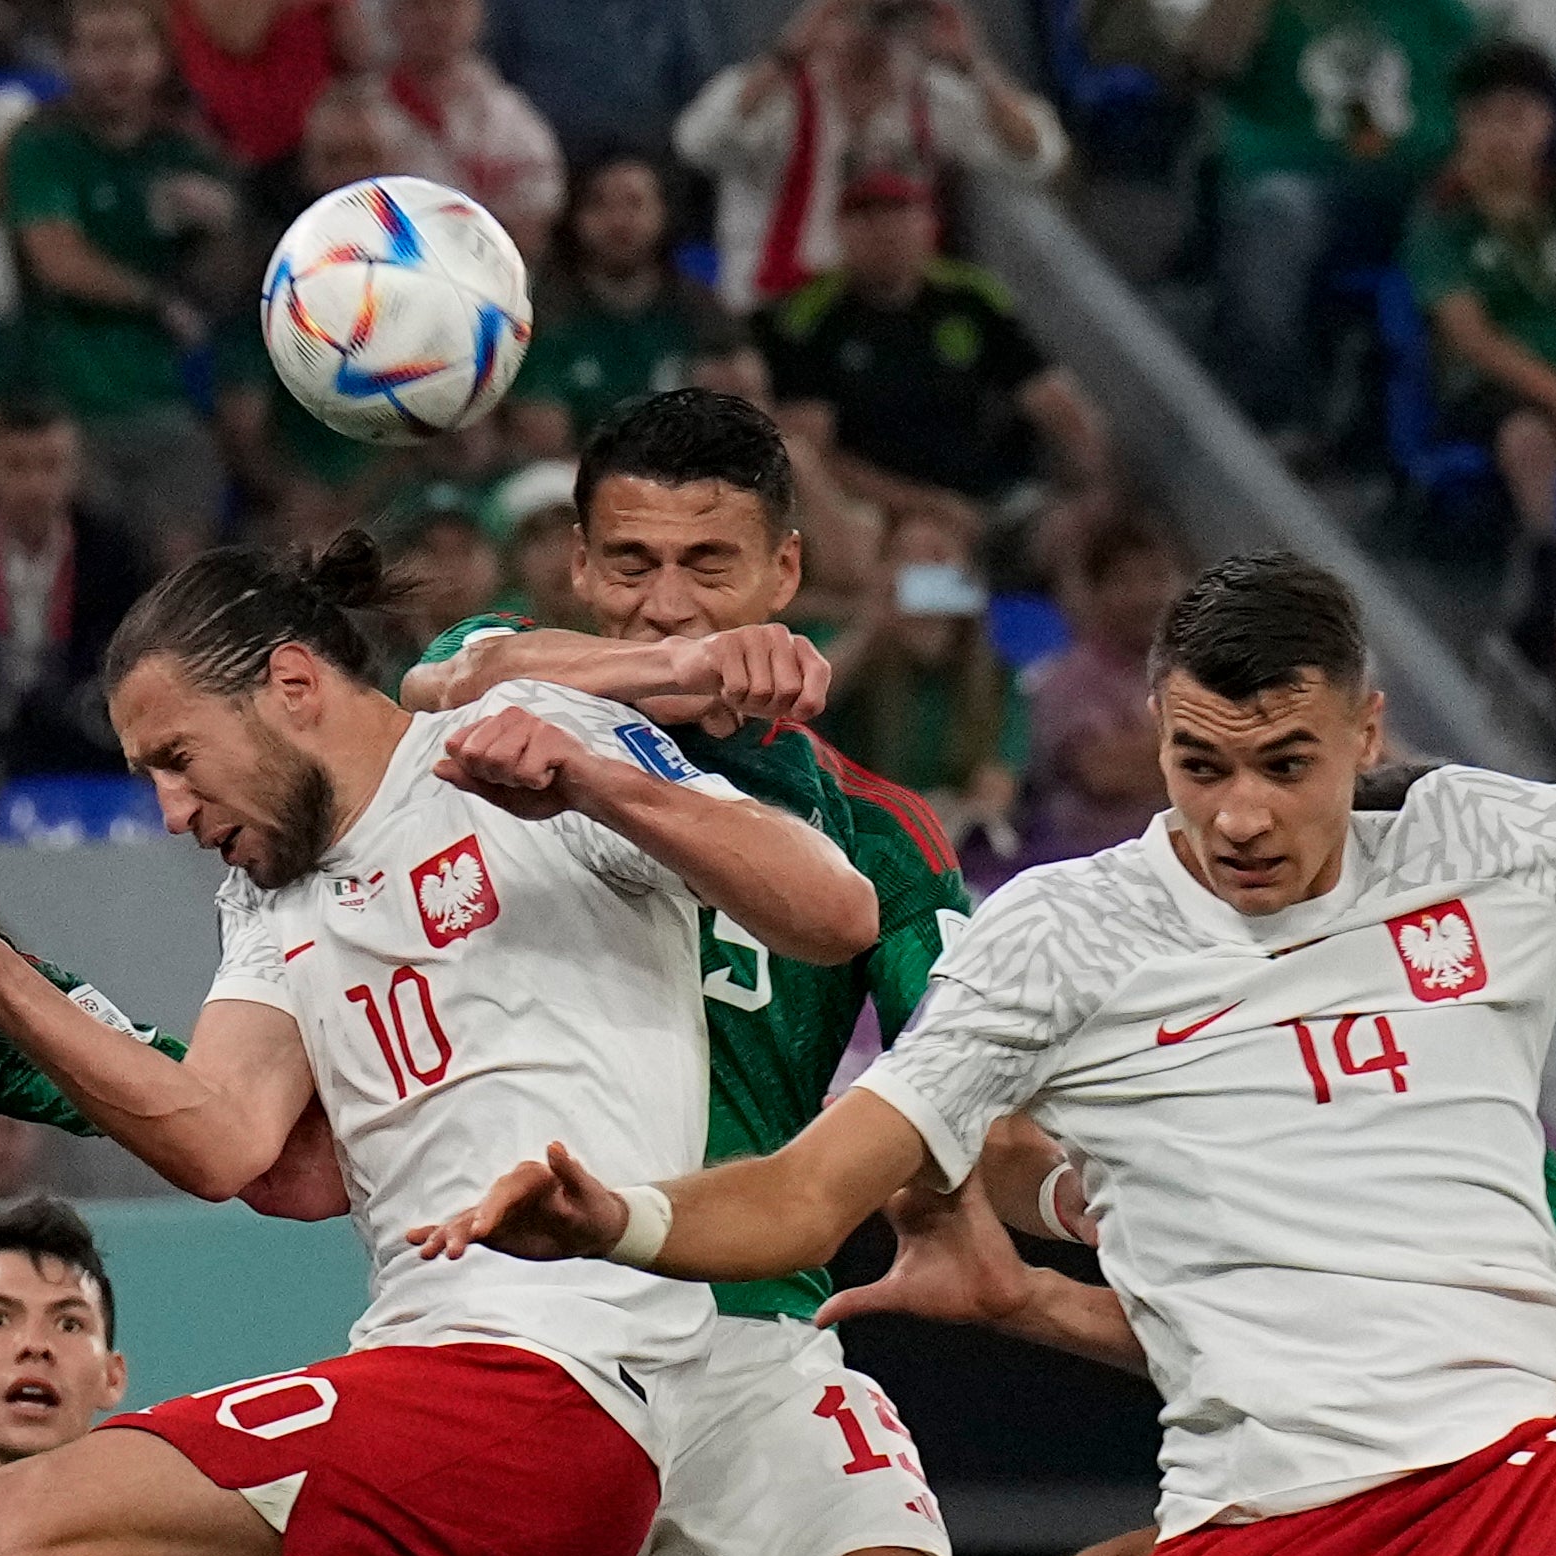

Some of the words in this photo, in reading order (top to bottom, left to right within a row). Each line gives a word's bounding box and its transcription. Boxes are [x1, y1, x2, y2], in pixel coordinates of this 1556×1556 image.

[702, 909, 773, 1012] 5
[345, 964, 453, 1099] 10
[1275, 1012, 1409, 1105] 14
